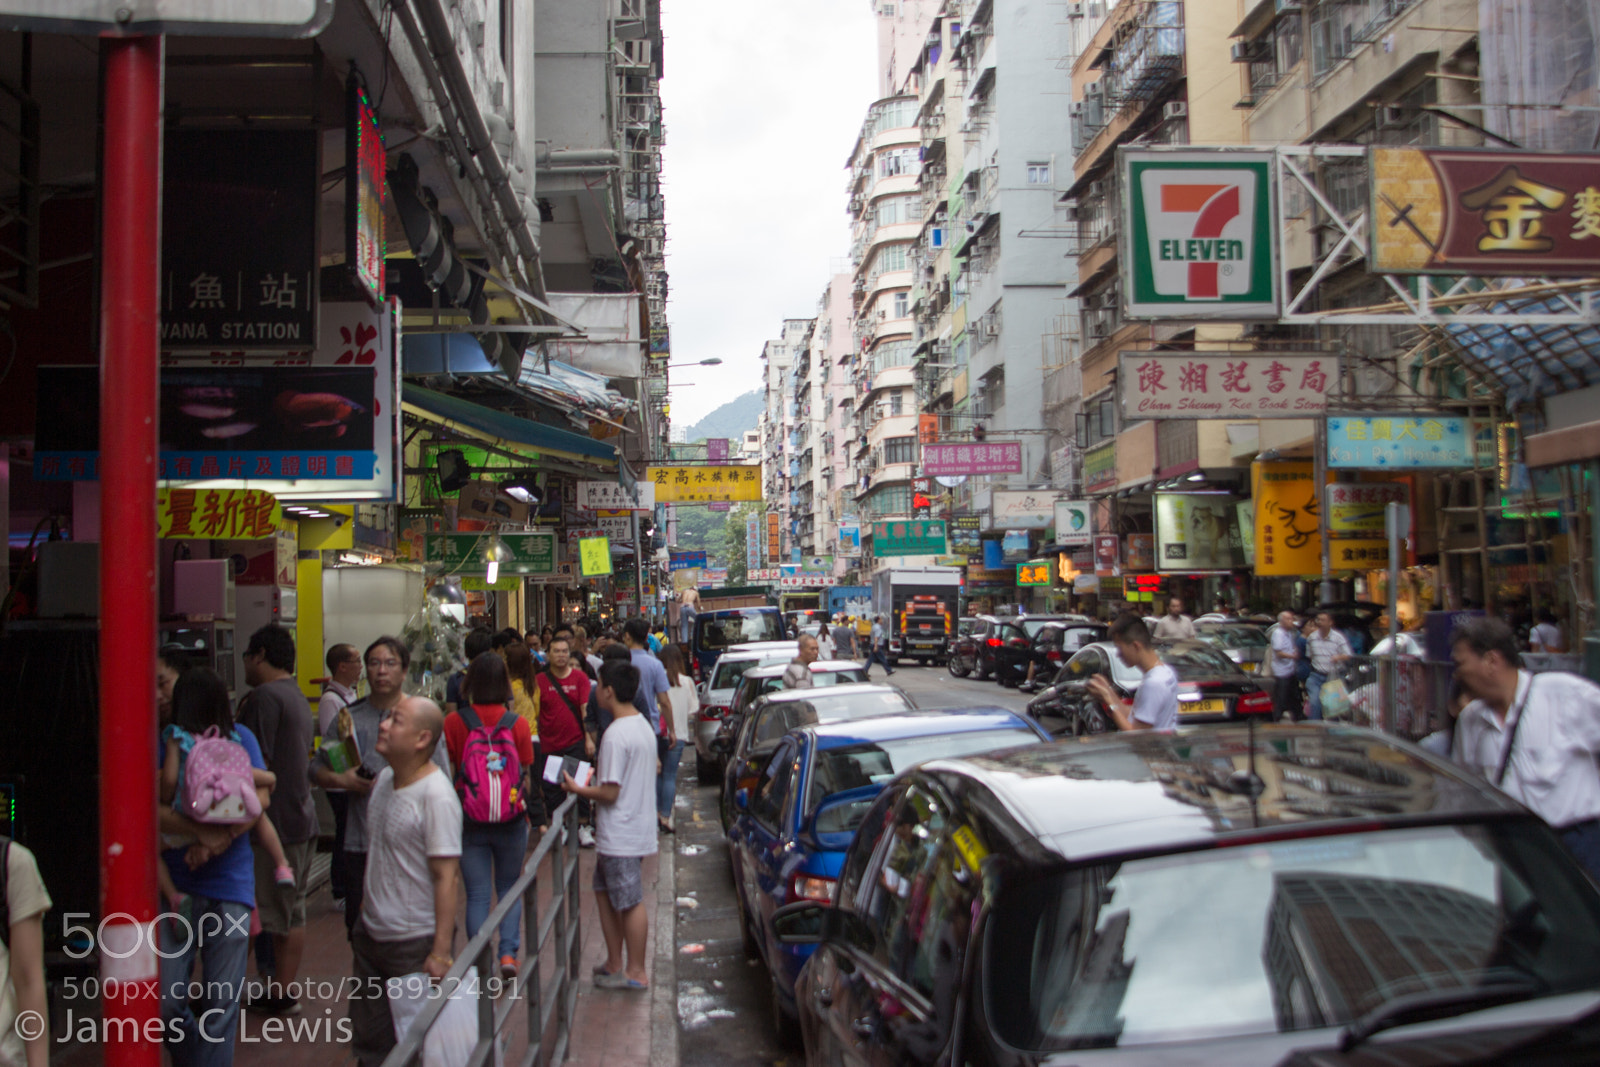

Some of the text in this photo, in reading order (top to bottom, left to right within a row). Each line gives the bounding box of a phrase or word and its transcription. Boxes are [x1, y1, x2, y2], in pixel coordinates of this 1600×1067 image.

[1160, 184, 1239, 297] 7
[222, 322, 300, 339] STATION
[1135, 359, 1328, 394] 陳湘記書局
[1137, 398, 1328, 412] Chan Sheung Kee Book Store
[1330, 447, 1361, 461] Kai
[1403, 447, 1459, 462] House
[655, 468, 755, 484] 宏高水族精品
